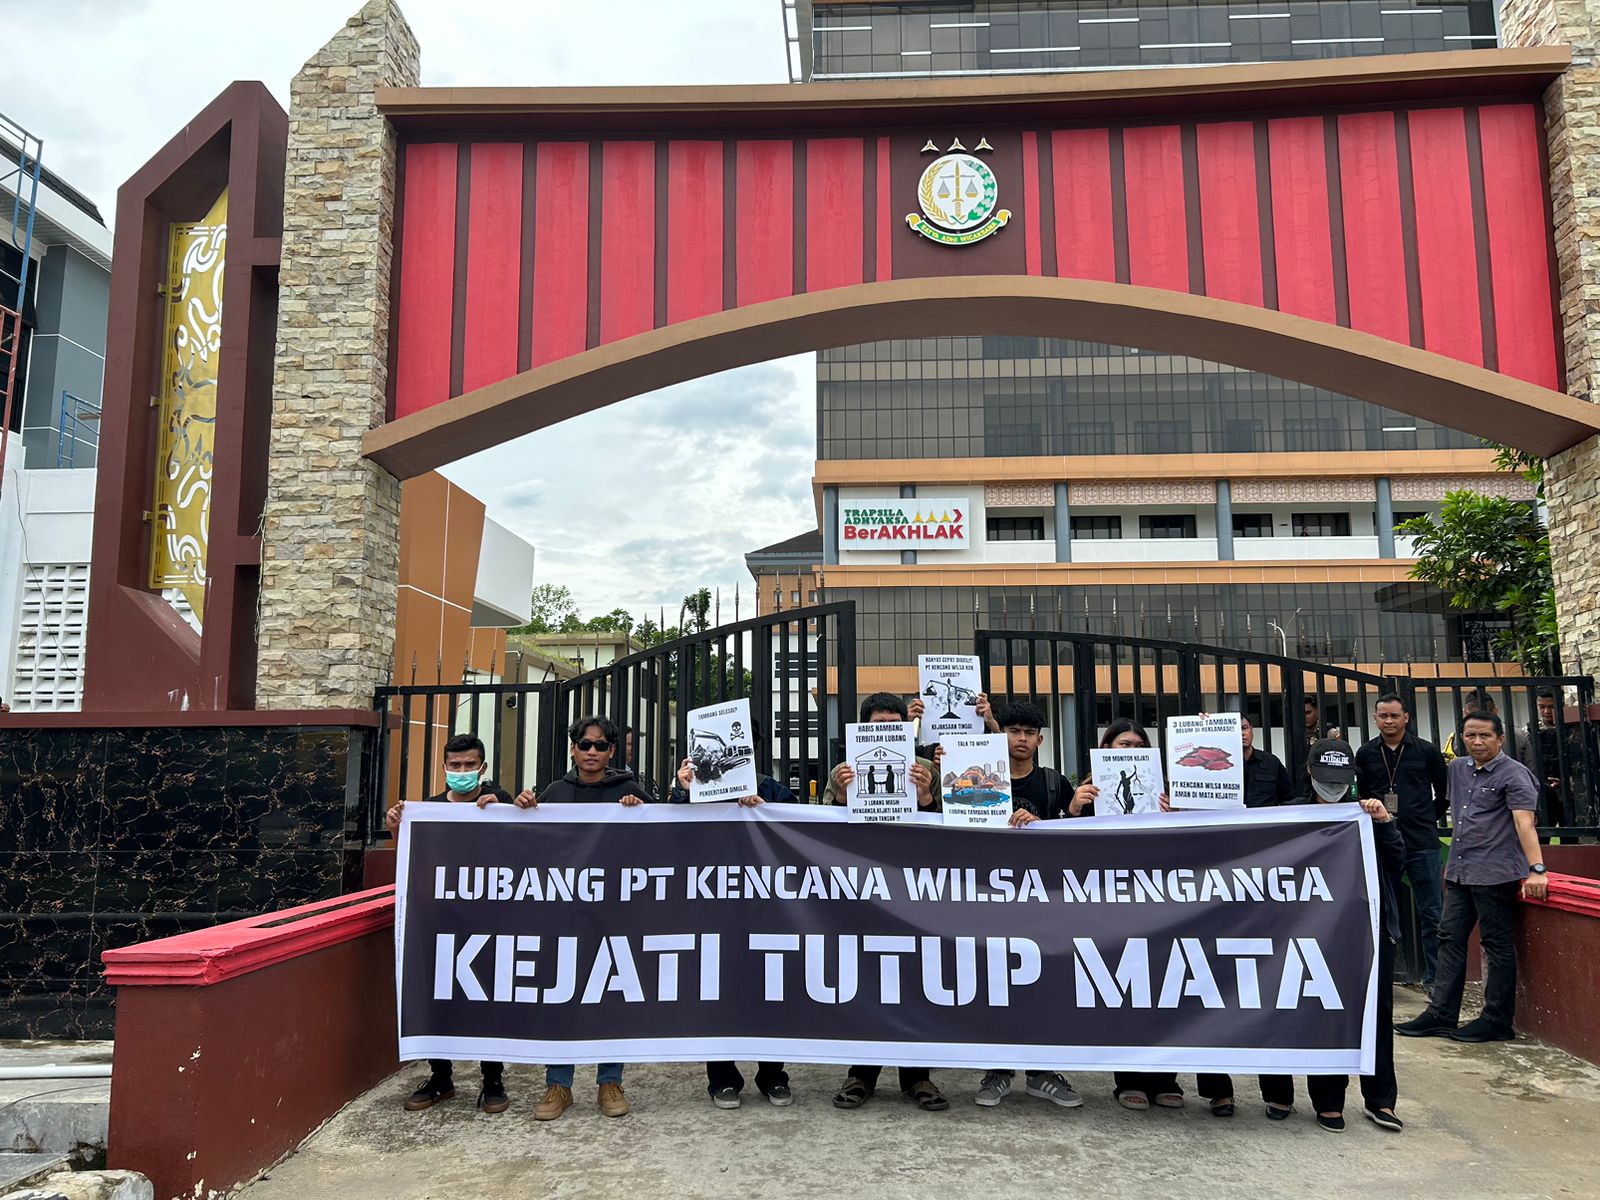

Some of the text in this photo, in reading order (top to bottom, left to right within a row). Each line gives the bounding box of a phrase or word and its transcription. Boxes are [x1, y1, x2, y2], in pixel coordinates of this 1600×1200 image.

[921, 224, 939, 239] SATYA
[960, 222, 997, 242] WICAKSANA
[844, 509, 904, 517] TRAPSILA
[844, 517, 909, 525] ADHYAKSA
[844, 525, 963, 540] BerAKHLAK
[876, 724, 904, 732] NAMBANG
[1179, 720, 1204, 728] LUBANG
[1205, 717, 1237, 726] TAMBANG
[699, 788, 728, 797] PENDERITAAN
[434, 865, 1334, 903] LUBANG PT KENCANA WILSA MENGANGA
[433, 933, 1345, 1010] KEJATI TUTUP MATA
